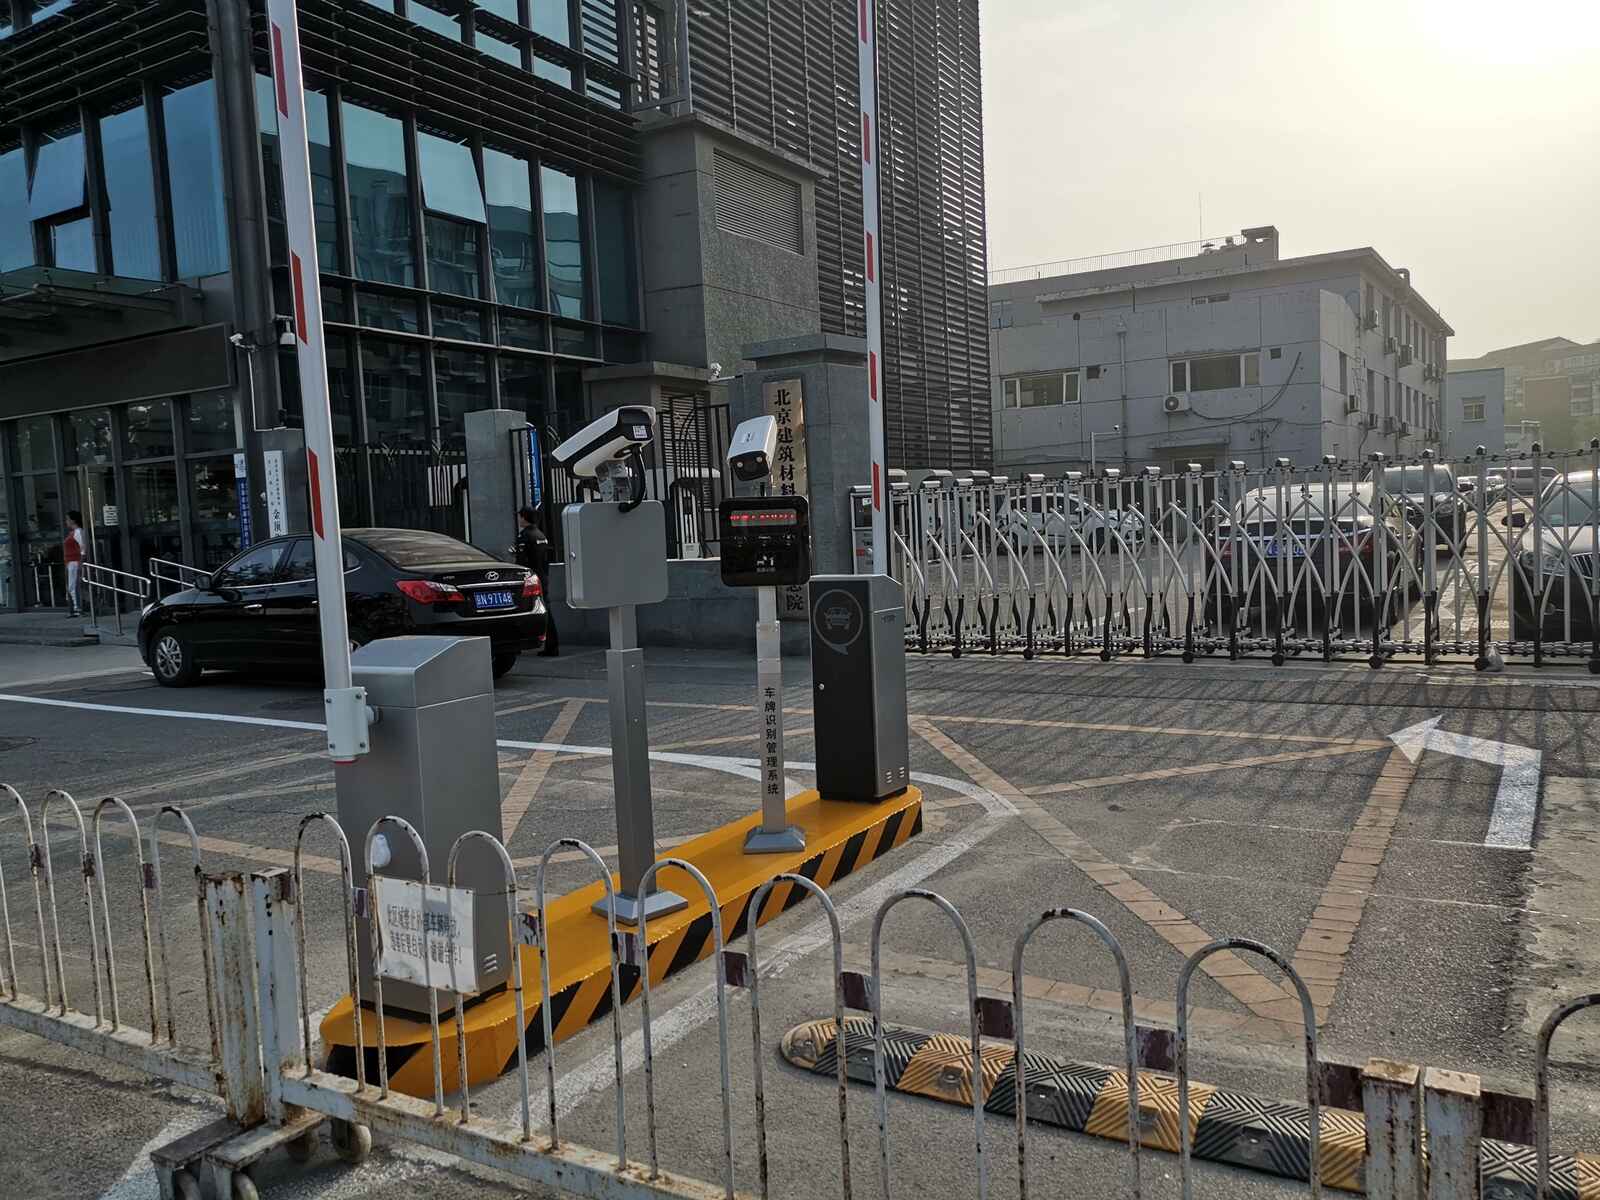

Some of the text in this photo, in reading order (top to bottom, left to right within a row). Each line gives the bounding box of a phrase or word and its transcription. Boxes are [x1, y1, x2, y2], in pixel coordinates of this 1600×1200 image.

[764, 686, 779, 795] 车牌识别管理系统
